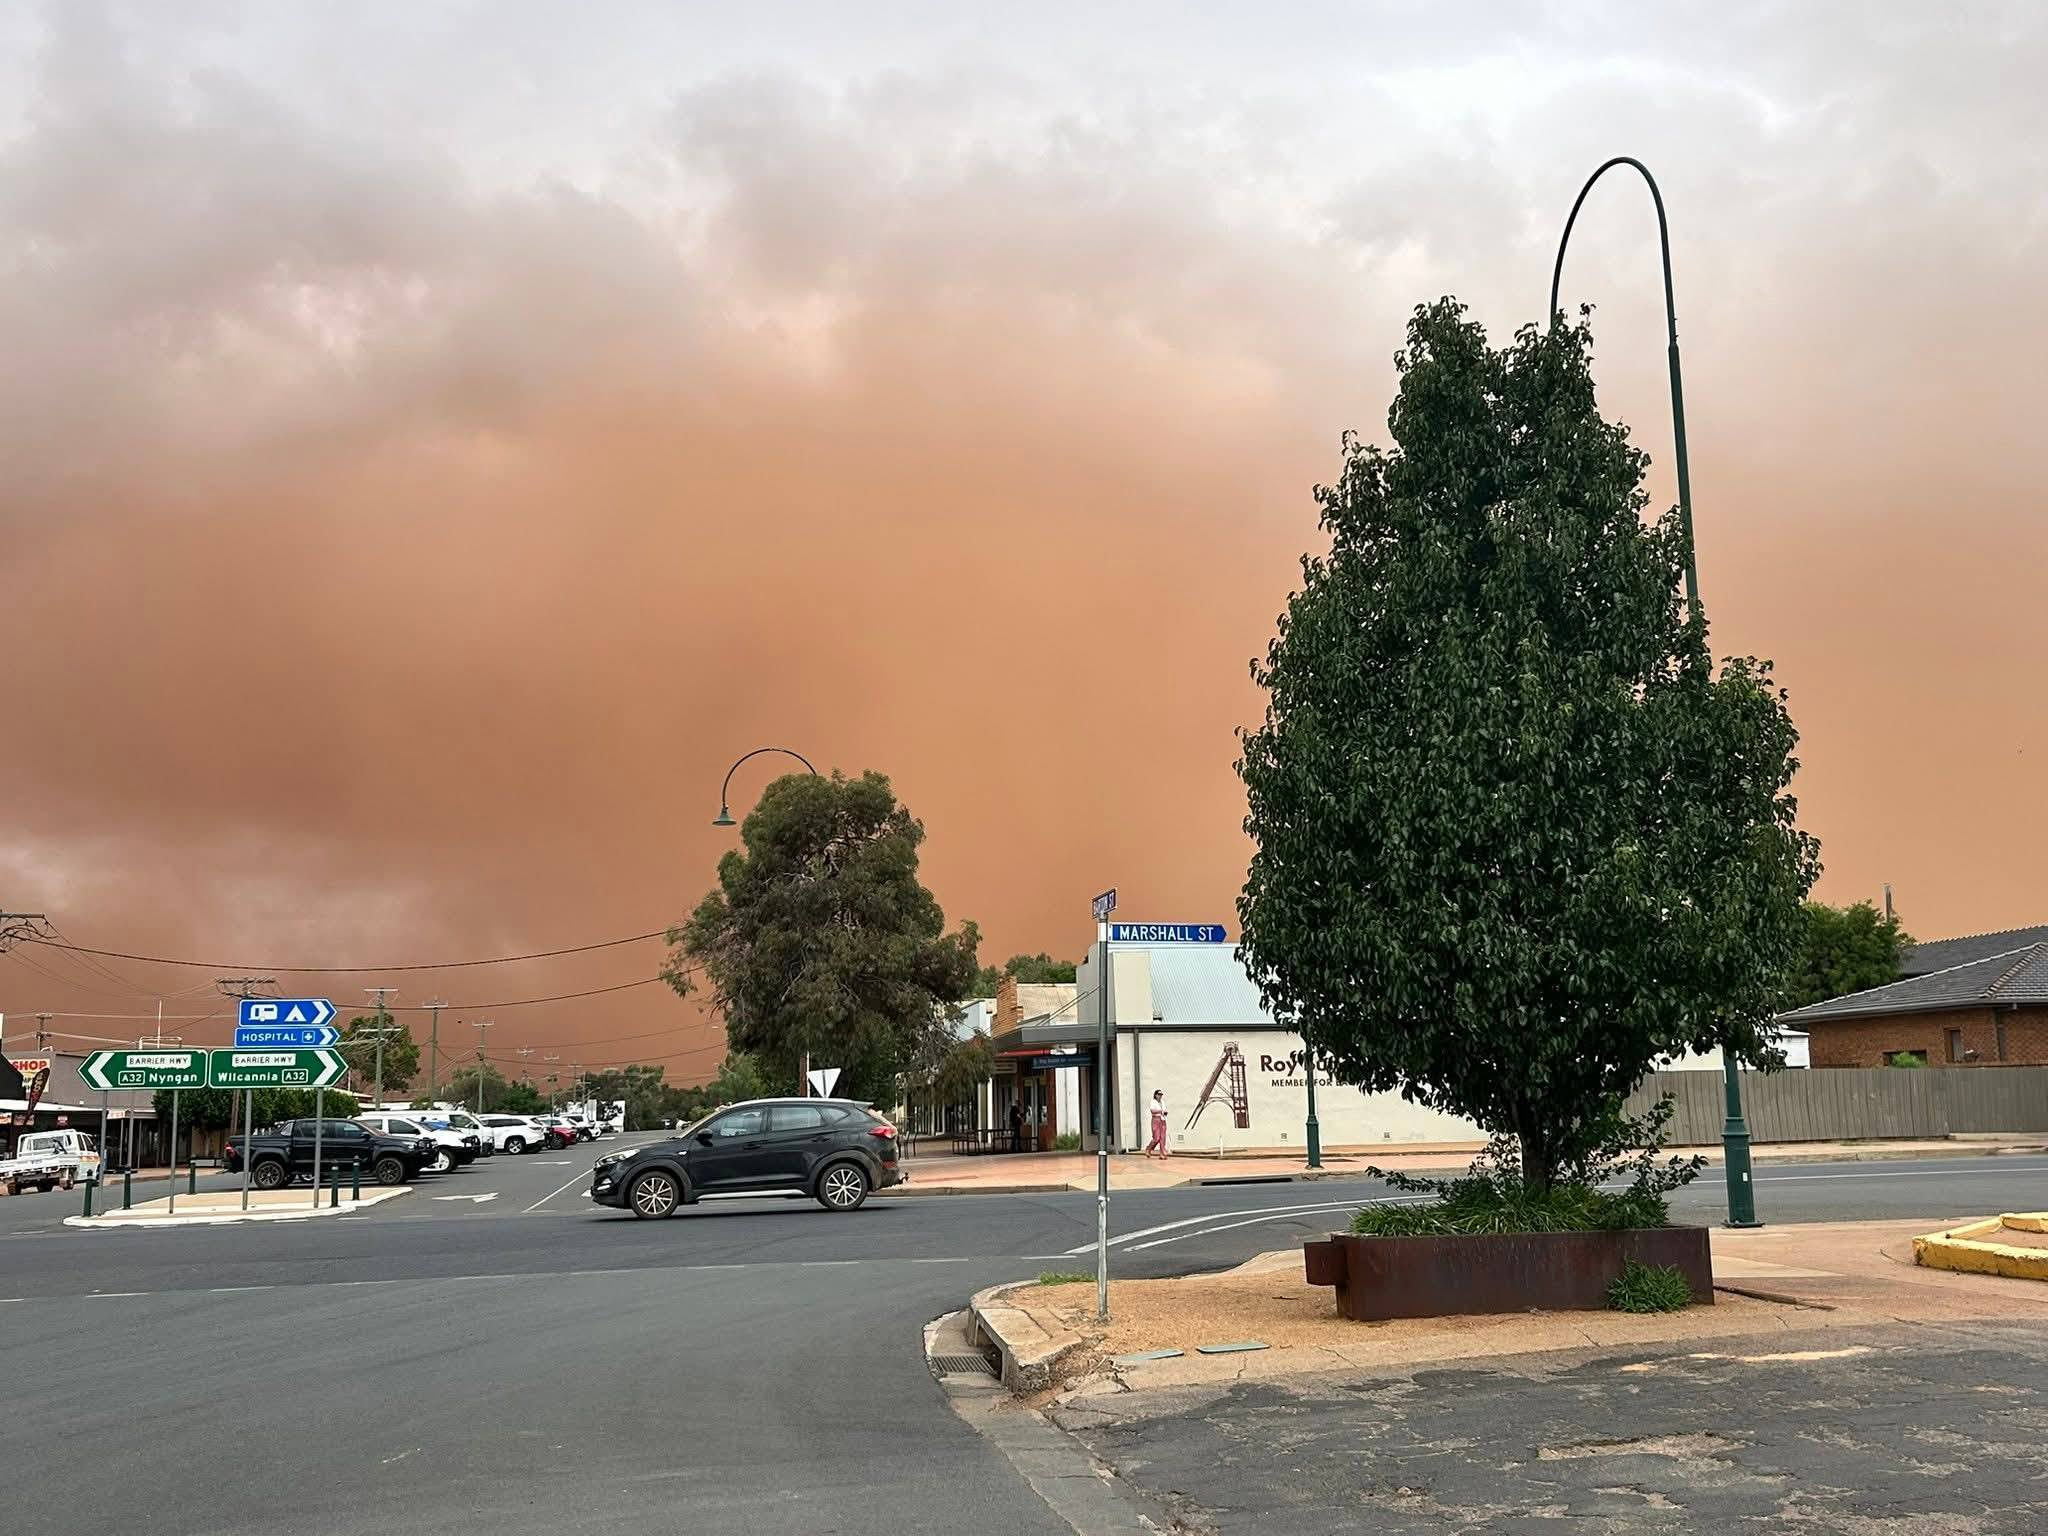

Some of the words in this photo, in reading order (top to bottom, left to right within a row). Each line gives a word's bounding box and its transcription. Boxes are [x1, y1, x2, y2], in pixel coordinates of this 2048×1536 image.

[1119, 926, 1193, 941] MARSHALL
[1198, 926, 1214, 941] ST
[242, 1033, 297, 1042] HOSPITAL
[129, 1057, 165, 1065] BARRIER
[234, 1056, 270, 1064] BARRIER
[1260, 1055, 1297, 1077] Roy
[121, 1073, 142, 1082] A32
[148, 1073, 198, 1084] Nyngan
[217, 1072, 278, 1082] Wilcannia
[285, 1072, 305, 1080] A32
